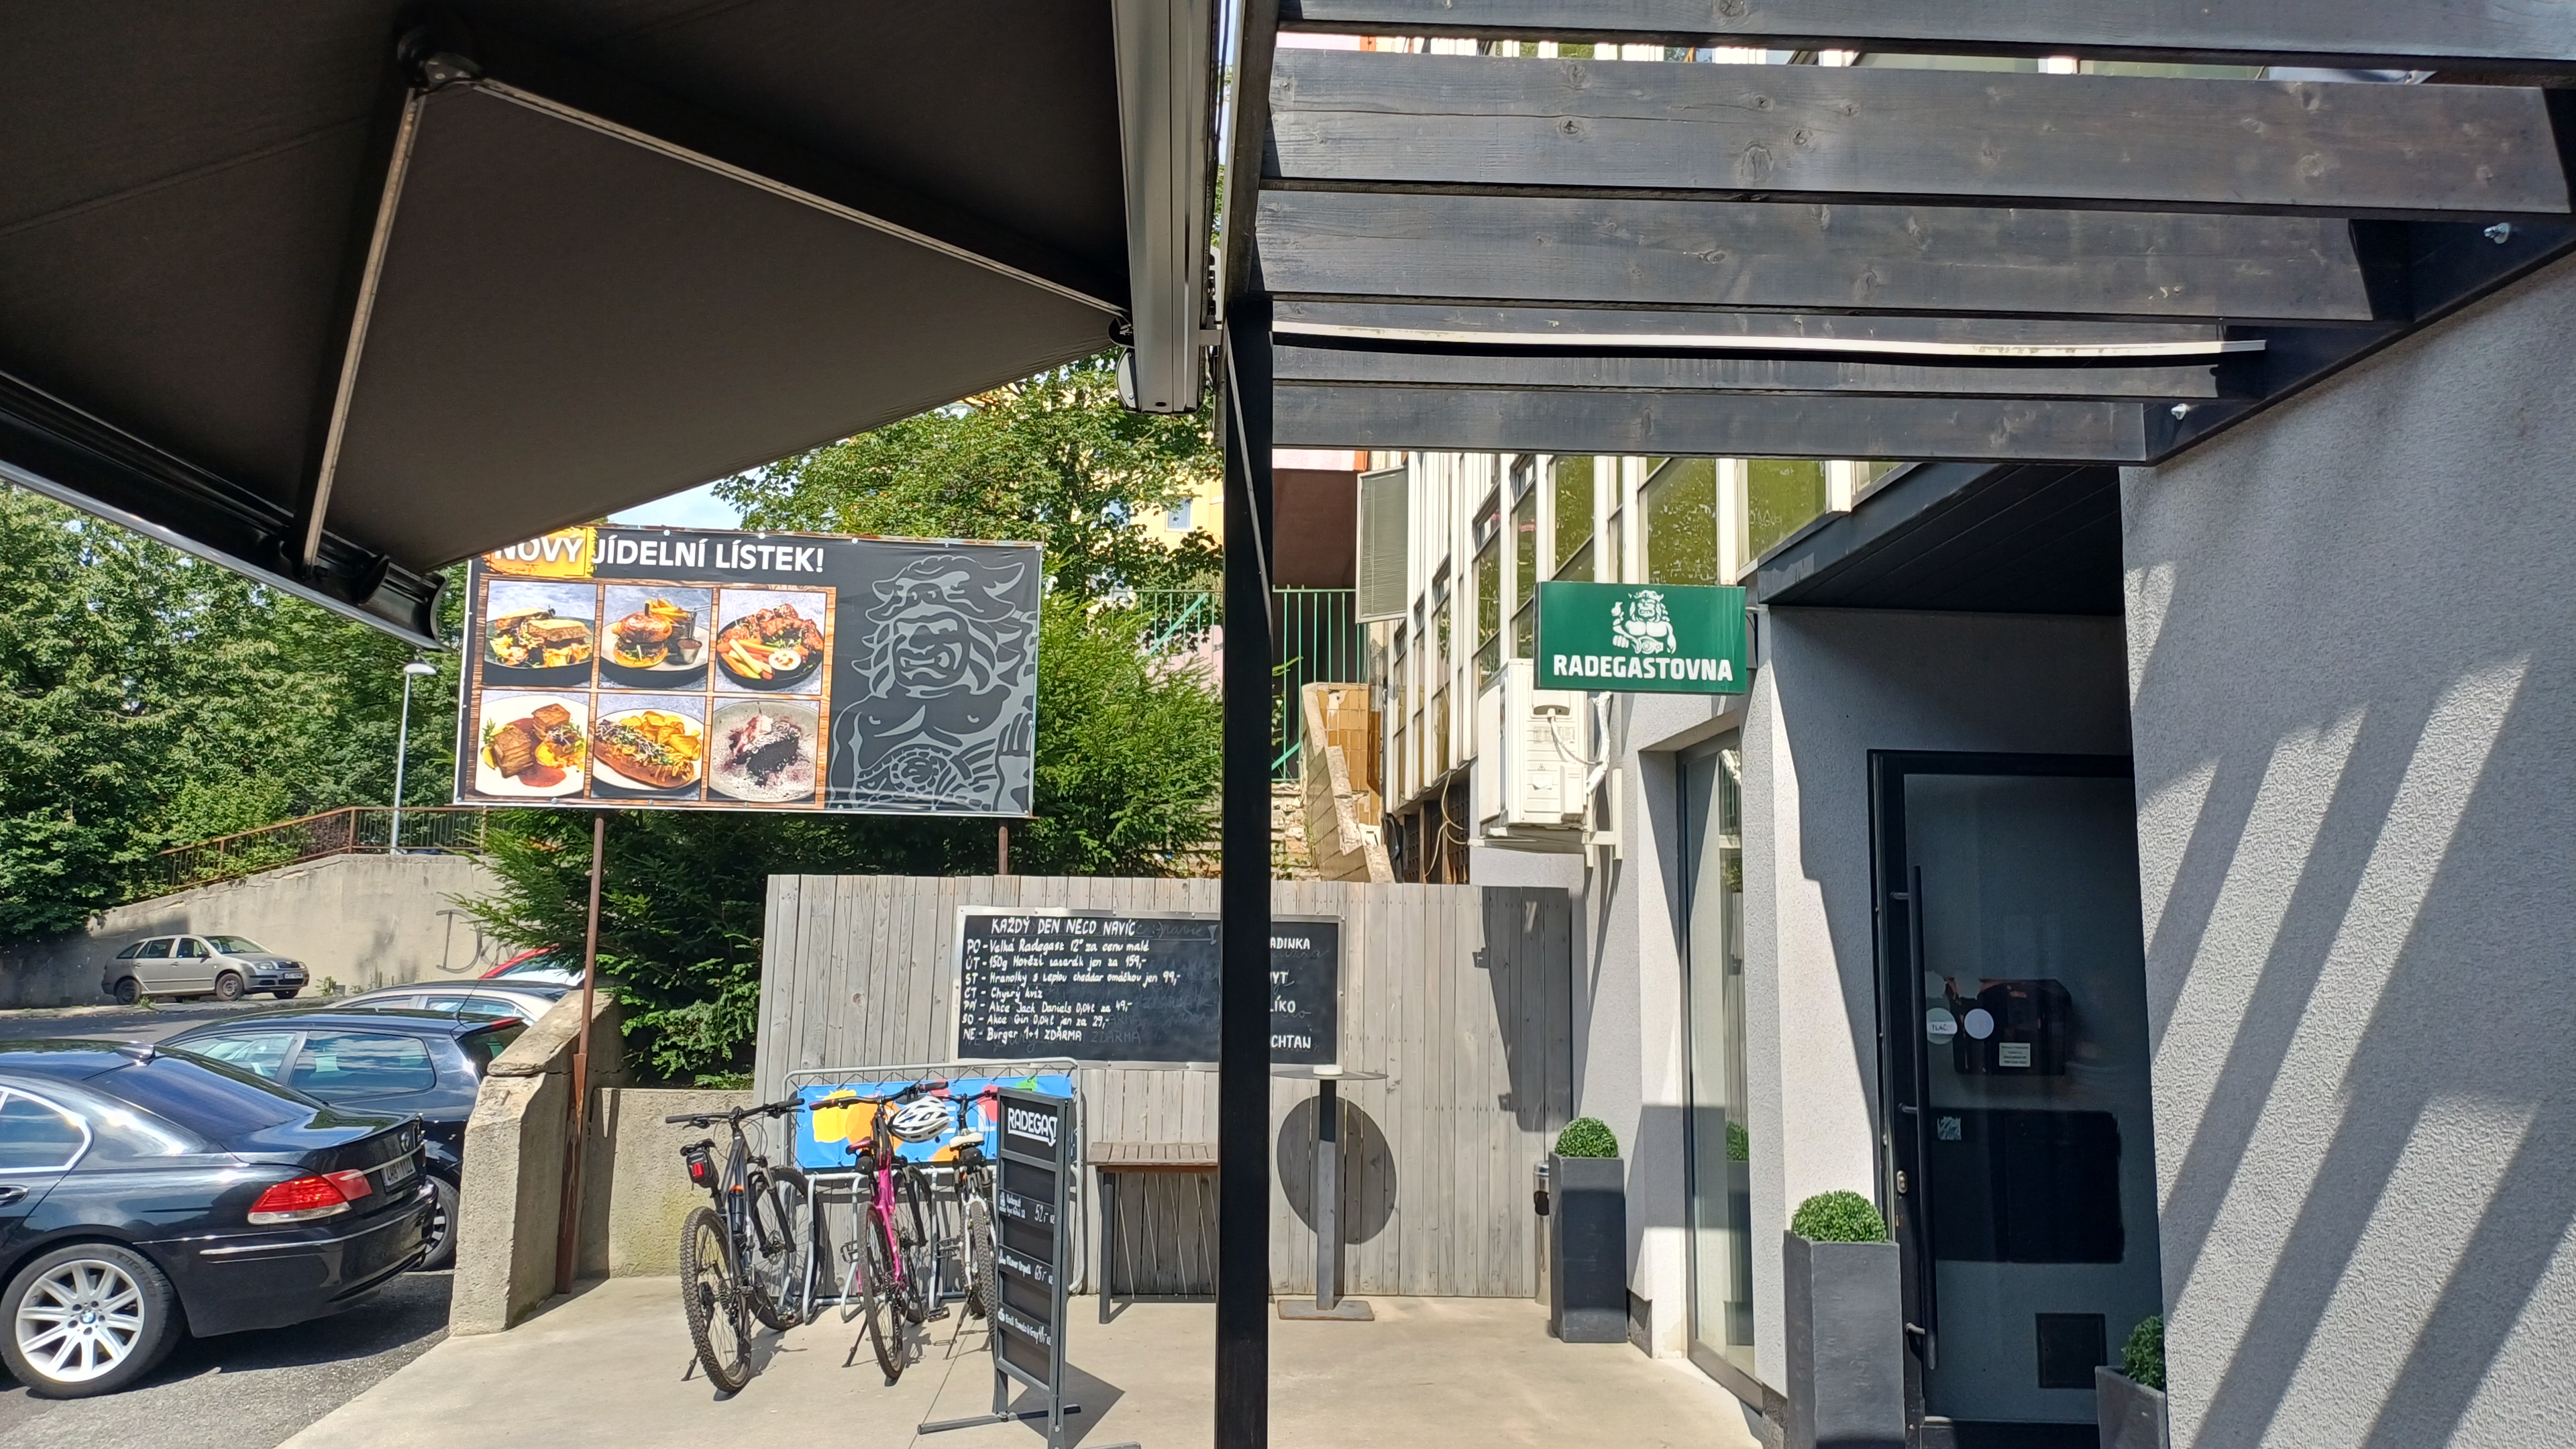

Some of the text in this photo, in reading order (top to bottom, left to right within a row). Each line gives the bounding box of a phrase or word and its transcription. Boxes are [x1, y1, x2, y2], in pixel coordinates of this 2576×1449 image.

[494, 534, 824, 574] NOVÝ JÍDELNÍ LÍSTEK!
[1554, 654, 1733, 682] RADEGASTOVNA
[991, 916, 1030, 934] KAŽDÝ
[1037, 918, 1061, 934] DEN
[1103, 918, 1136, 936] NAVÍC
[967, 938, 981, 955] PO
[989, 938, 1015, 953] Velká
[1018, 938, 1065, 956] Radegast
[1085, 943, 1098, 953] za
[1102, 943, 1124, 953] cenu
[1270, 936, 1311, 950] ADINKA
[965, 955, 980, 971] ÚT
[989, 955, 1008, 971] 150g
[1087, 956, 1102, 971] jen
[1107, 957, 1118, 967] za
[965, 972, 979, 985] ST
[989, 971, 1028, 988] Hranolky
[1032, 972, 1038, 983] s
[1042, 971, 1068, 986] teplou
[1073, 971, 1104, 983] cheddar
[1142, 973, 1158, 988] jen
[991, 986, 1021, 1004] Chytrý
[988, 1001, 1011, 1014] Akce
[1016, 1002, 1036, 1014] Jack
[1041, 1000, 1072, 1014] Daniels
[1100, 1005, 1112, 1013] za
[961, 1013, 974, 1025] SO
[987, 1013, 1008, 1025] Akce
[1014, 1014, 1029, 1025] Gin
[1057, 1016, 1073, 1031] jen
[1075, 1018, 1087, 1027] za
[963, 1028, 977, 1040] NE
[986, 1026, 1018, 1045] Burger
[1024, 1026, 1039, 1040] 1+1
[1044, 1028, 1082, 1042] ZDARMA
[1271, 1034, 1311, 1049] CHTAN
[1008, 1105, 1059, 1148] RADEGAST
